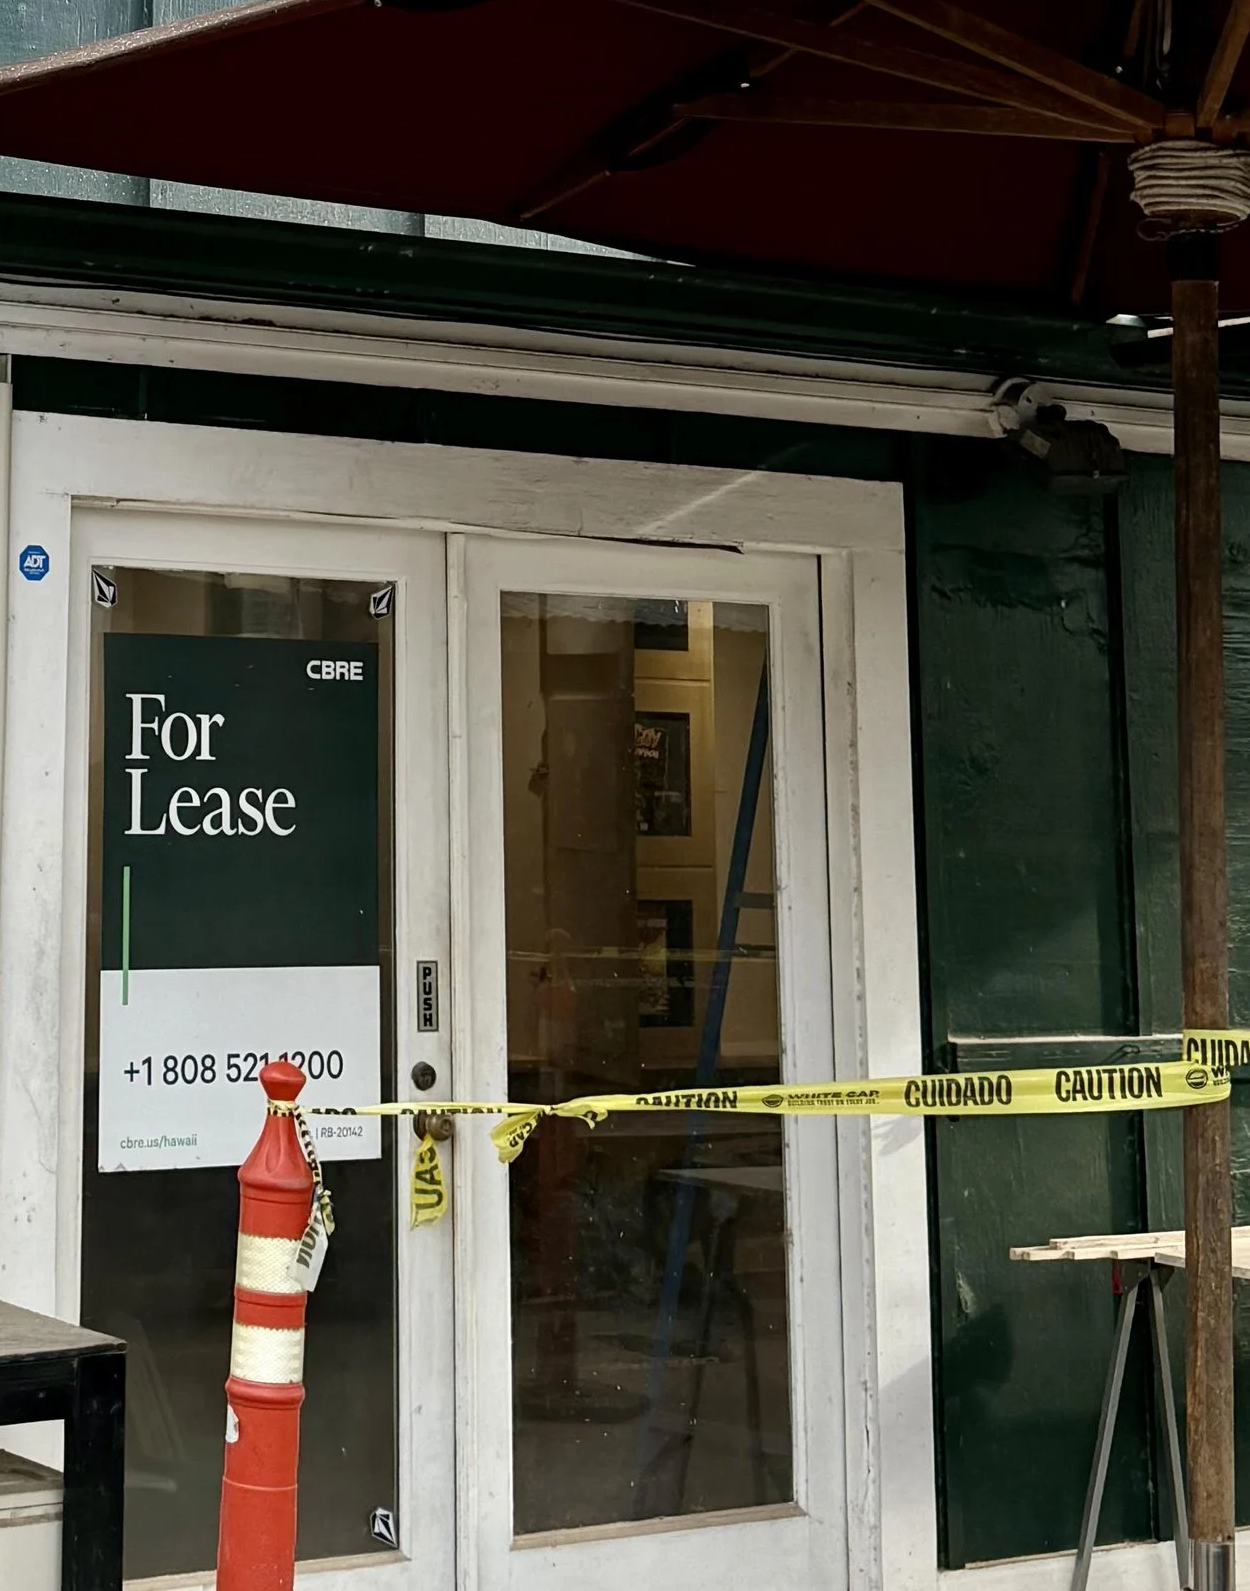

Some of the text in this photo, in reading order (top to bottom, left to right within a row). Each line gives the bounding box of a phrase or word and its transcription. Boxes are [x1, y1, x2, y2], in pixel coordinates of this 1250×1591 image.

[23, 554, 47, 569] ADT
[306, 659, 364, 681] CBRE
[125, 693, 226, 761] For
[124, 768, 297, 837] Lease
[423, 966, 433, 1027] PUSH
[123, 1055, 152, 1086] +1
[162, 1054, 217, 1085] 808
[1055, 1066, 1163, 1102] CAUTION
[904, 1074, 1012, 1107] CUIDADO
[120, 1133, 198, 1149] cbre.us/hawaii
